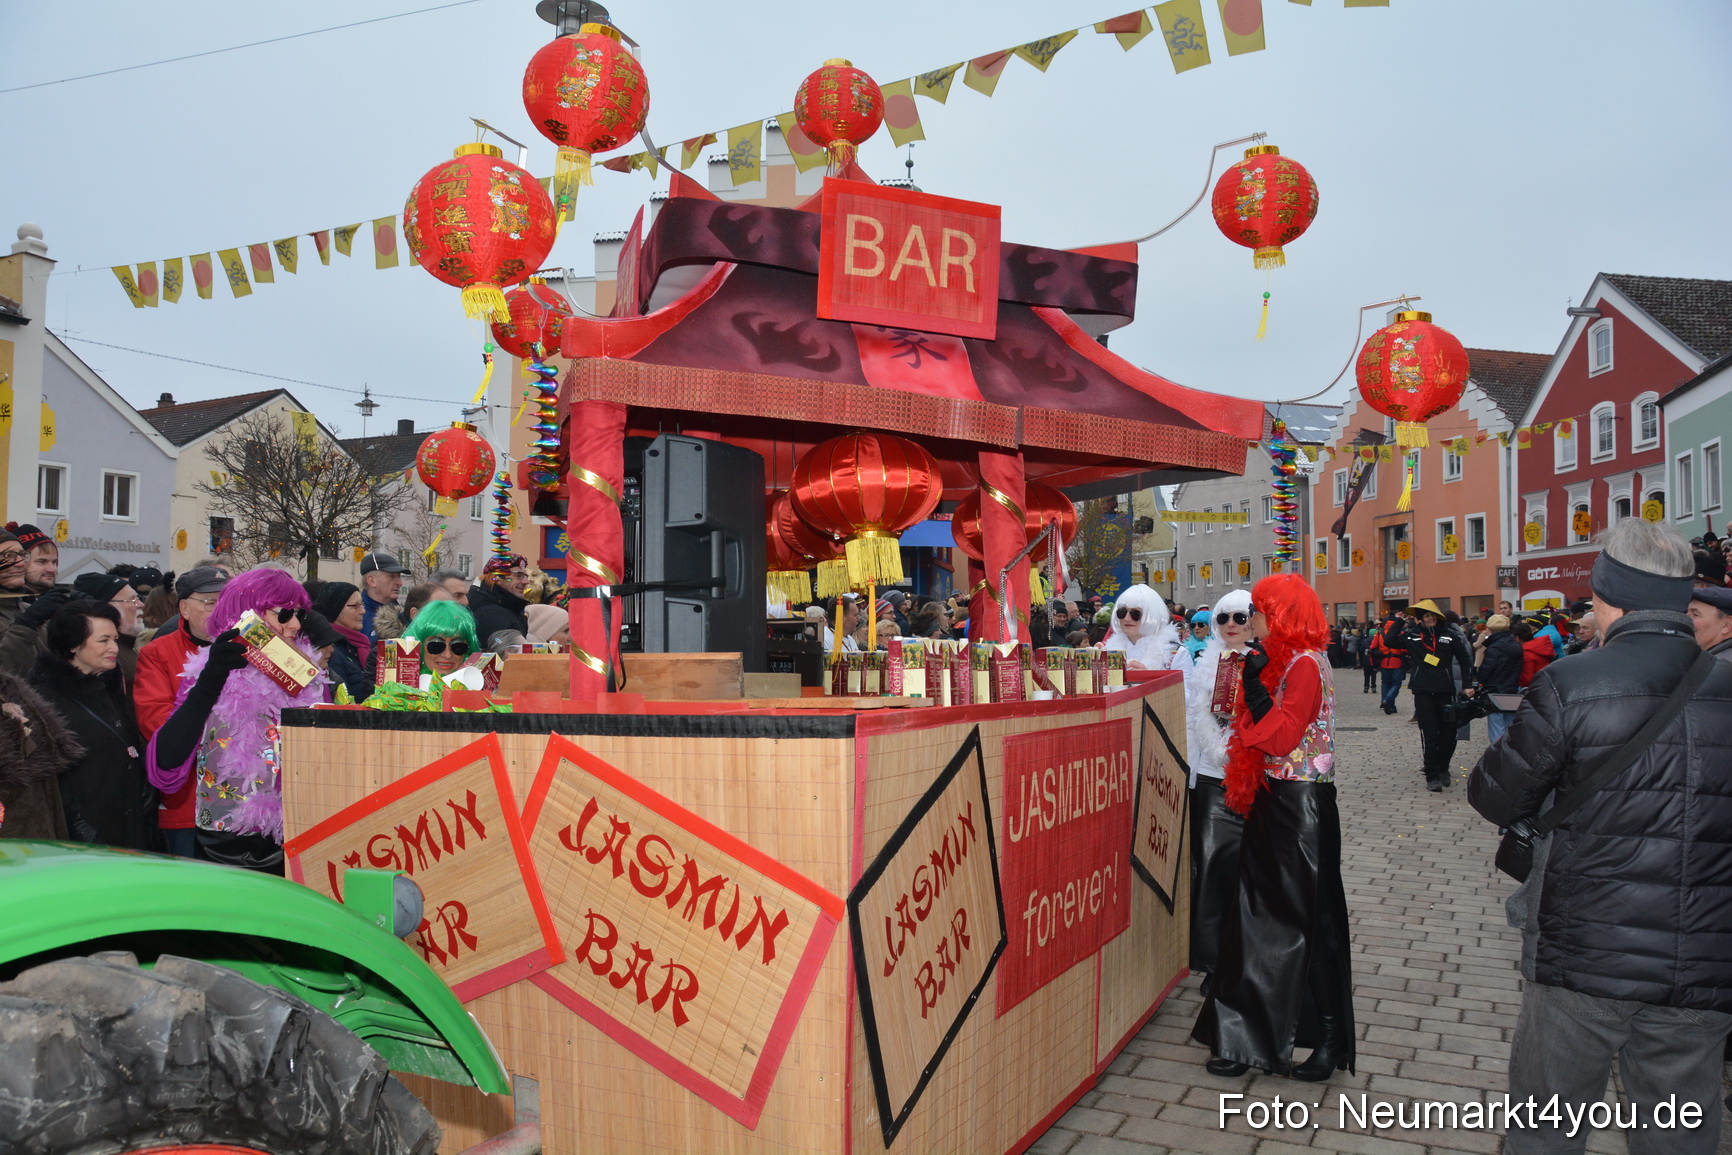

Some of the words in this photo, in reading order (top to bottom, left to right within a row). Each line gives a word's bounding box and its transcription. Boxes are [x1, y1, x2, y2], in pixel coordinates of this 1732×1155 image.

[844, 213, 977, 293] BAR
[55, 534, 161, 553] aiffeisenbank
[1498, 567, 1516, 577] CAFÉ
[1383, 585, 1410, 596] GÖTZ
[245, 645, 298, 692] RATSTROPFEN
[1009, 750, 1130, 843] JASMINBAR
[1148, 812, 1169, 864] BAR
[558, 796, 790, 966] JASMIN
[883, 800, 977, 978] JASMIN
[1023, 851, 1119, 957] forever!
[403, 900, 479, 967] AR
[575, 908, 700, 1028] BAR
[914, 907, 971, 1020] BAR
